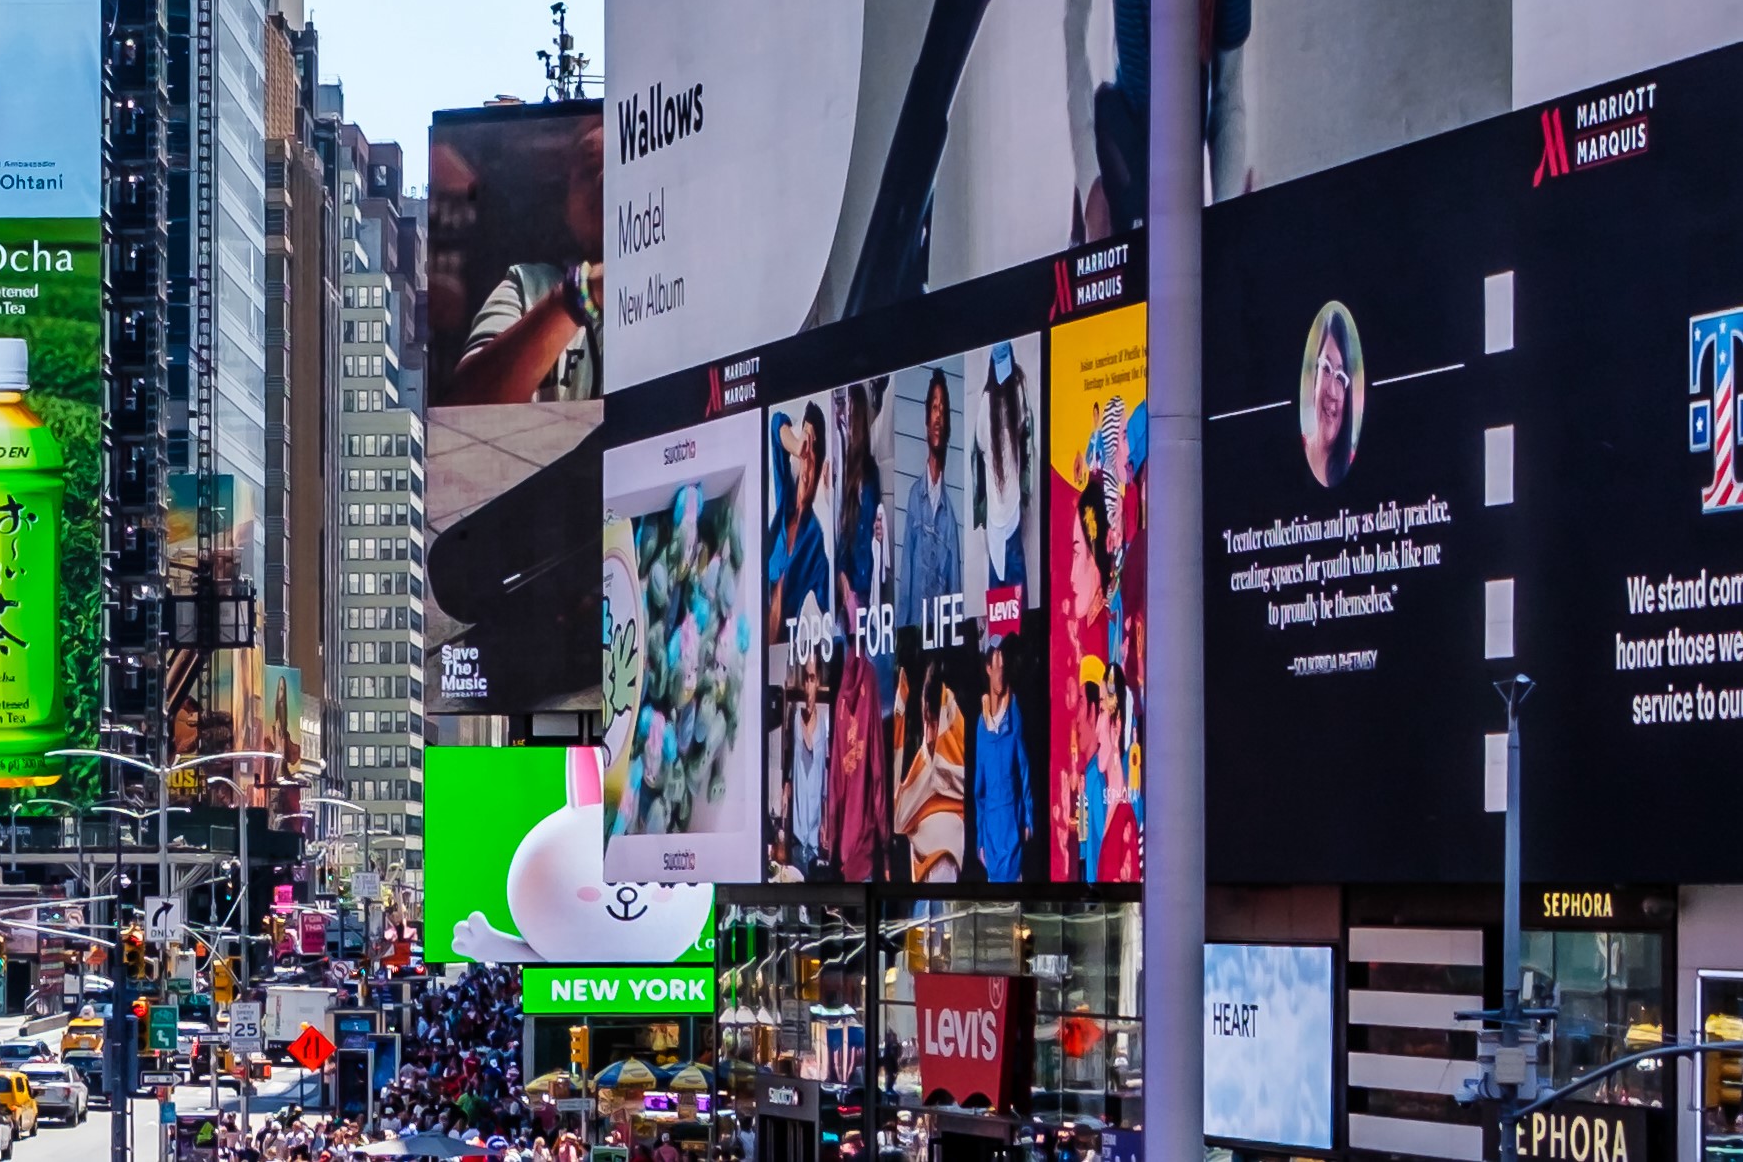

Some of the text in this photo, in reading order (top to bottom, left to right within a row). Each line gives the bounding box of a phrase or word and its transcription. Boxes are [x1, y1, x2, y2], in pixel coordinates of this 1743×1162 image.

[1576, 83, 1656, 130] MARRIOTT
[618, 81, 704, 166] Wallows
[1576, 123, 1647, 166] MARQUIS
[0, 173, 63, 190] Ohtani
[618, 186, 666, 259] Model
[1077, 244, 1129, 277] MARRIOTT
[618, 272, 685, 330] New Album
[1077, 275, 1123, 306] MARQUIS
[3, 302, 26, 315] Tea
[723, 356, 760, 382] MARRIOTT
[723, 380, 756, 407] MARQUIS
[9, 447, 31, 458] EN
[1233, 527, 1263, 553] center
[1264, 515, 1322, 548] collectivism
[1323, 509, 1344, 539] and
[1344, 508, 1360, 542] joy
[1362, 512, 1375, 534] as
[1375, 501, 1401, 535] daily
[1231, 538, 1441, 593] creating spaces for youth who look like me
[1627, 575, 1655, 614] We
[1657, 568, 1706, 613] stand
[1268, 601, 1279, 626] to
[1280, 593, 1319, 630] proudly
[1320, 591, 1333, 620] be
[786, 593, 964, 666] TOPS FOR LIFE
[441, 644, 479, 660] Save
[1616, 626, 1743, 670] honor those we
[441, 659, 472, 675] The
[441, 675, 487, 691] Music
[6, 713, 27, 724] Tea
[1632, 684, 1693, 725] service
[1696, 682, 1715, 720] to
[1543, 892, 1613, 918] SEPHORA
[150, 929, 176, 938] ONLY
[551, 978, 706, 1002] NEW YORK
[235, 1023, 257, 1037] 25
[1213, 1002, 1258, 1039] HEART
[1499, 1112, 1628, 1162] EPHORA
